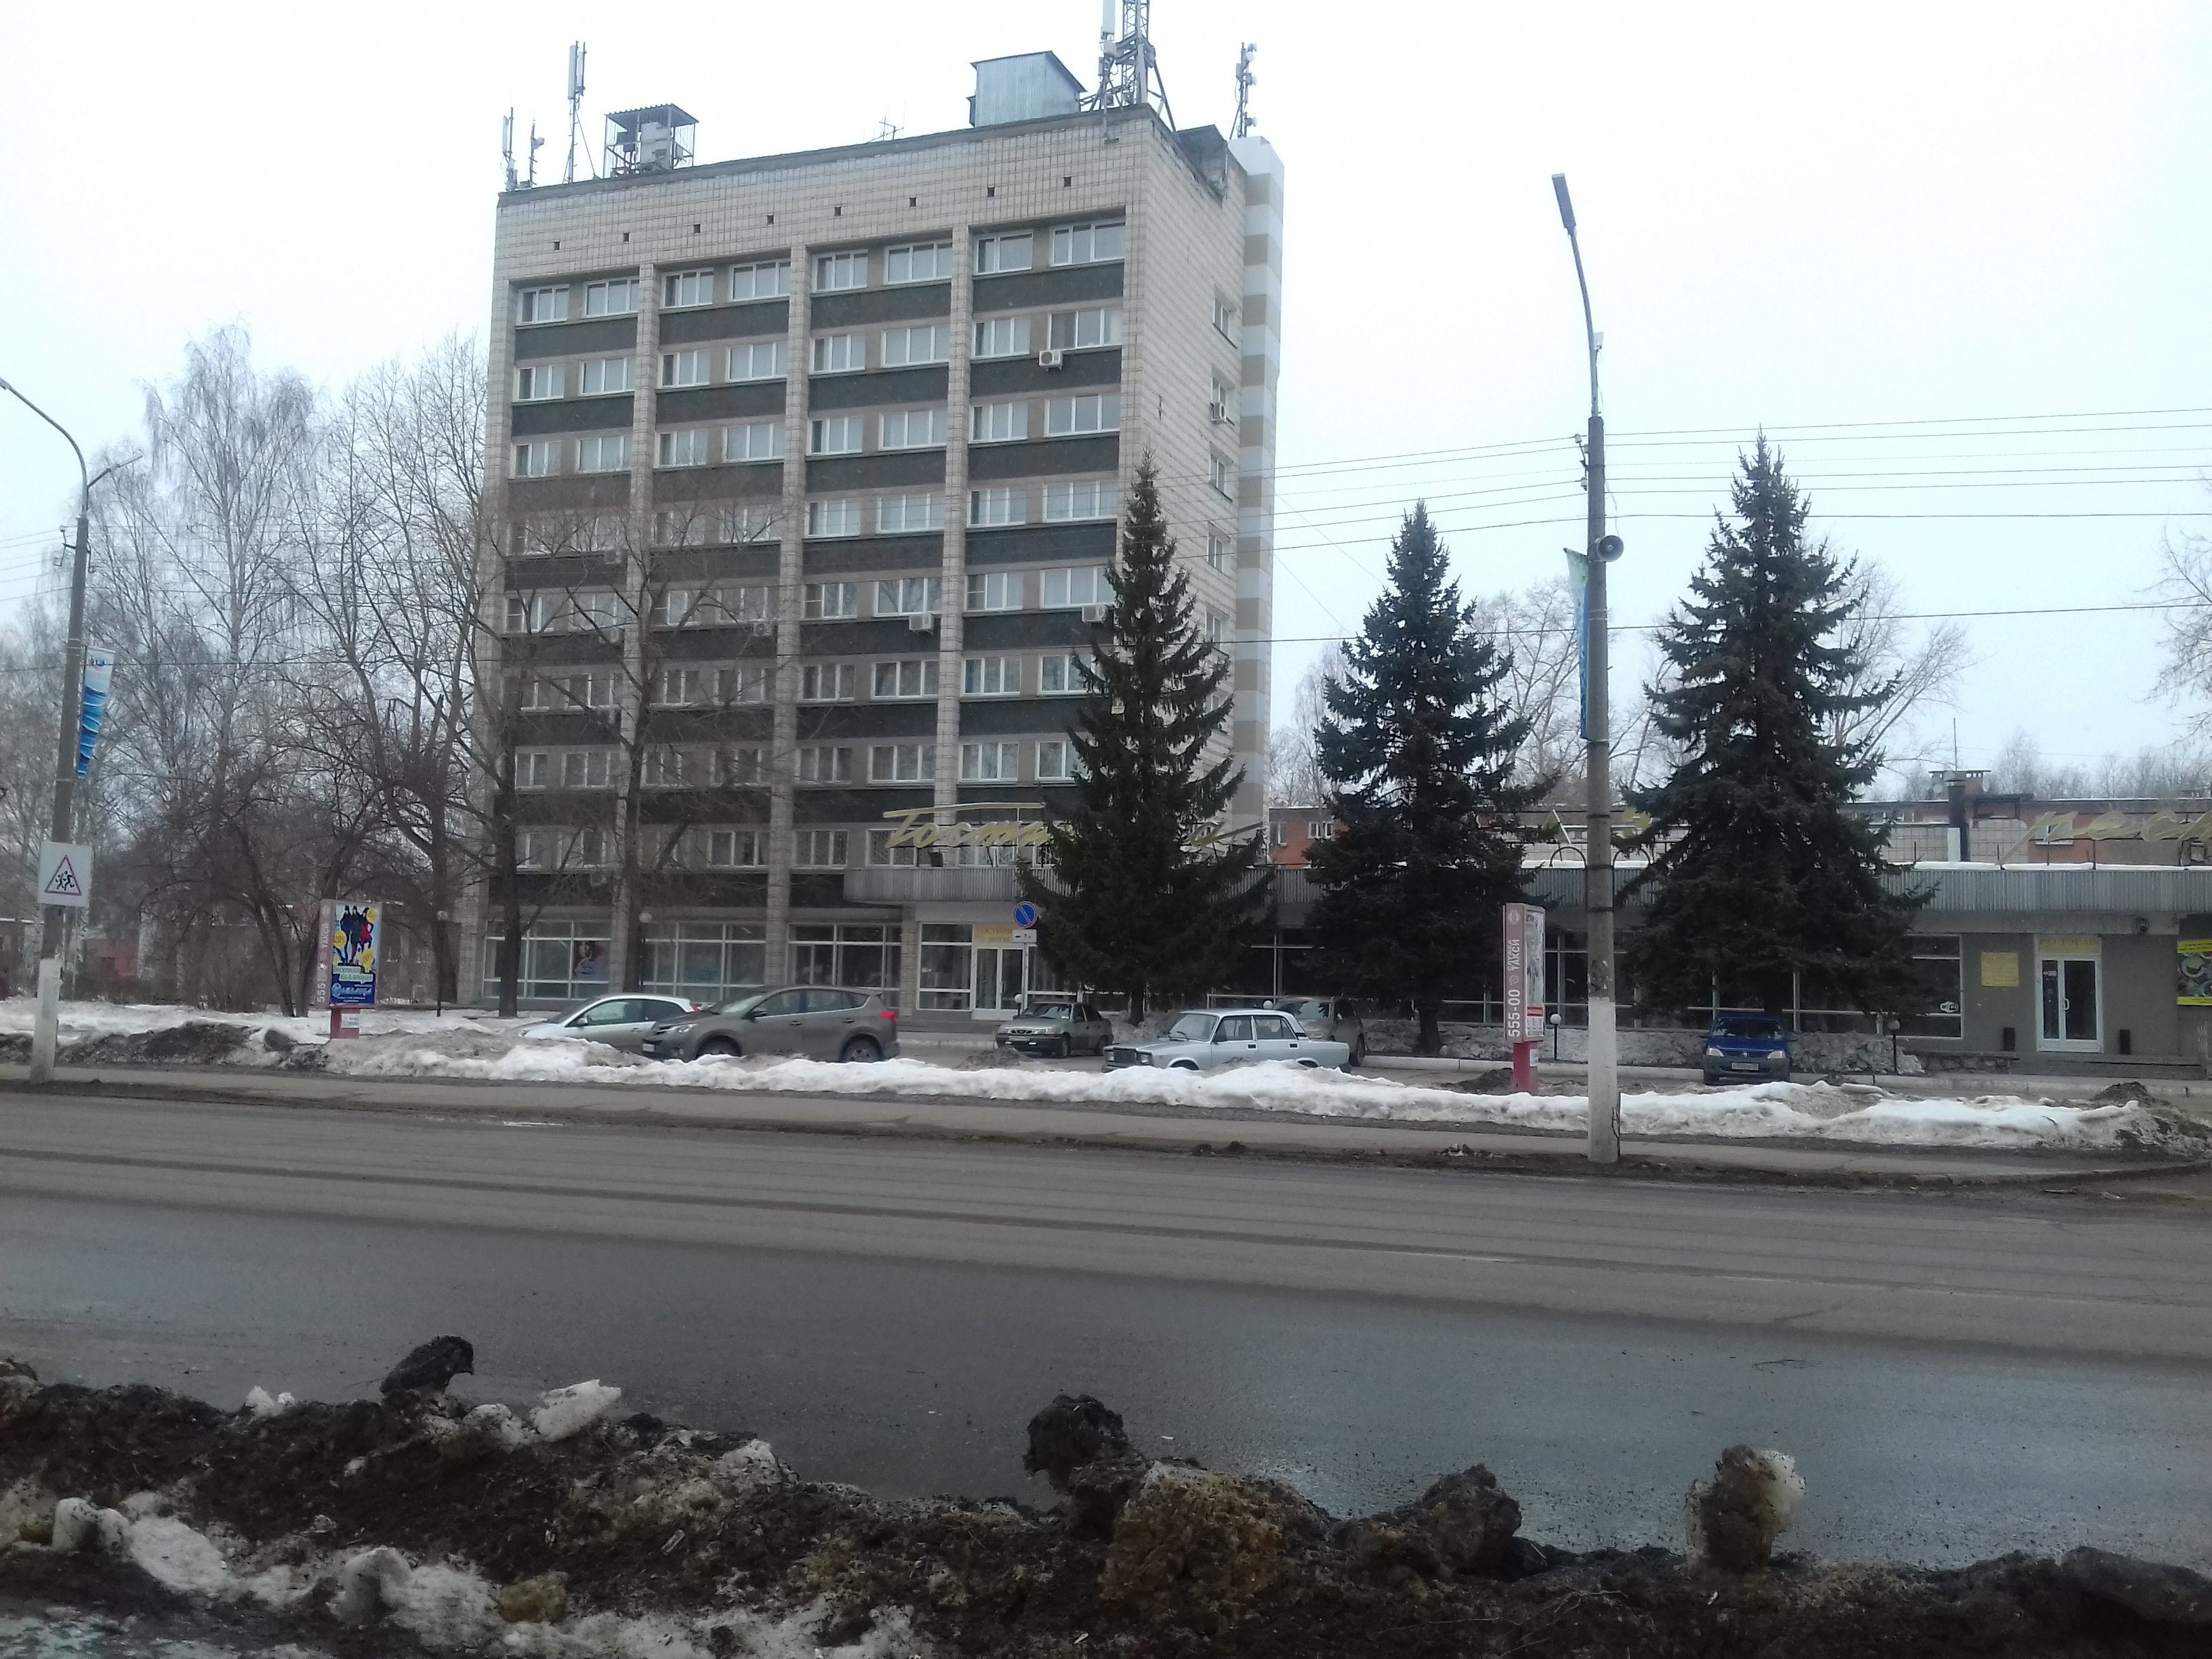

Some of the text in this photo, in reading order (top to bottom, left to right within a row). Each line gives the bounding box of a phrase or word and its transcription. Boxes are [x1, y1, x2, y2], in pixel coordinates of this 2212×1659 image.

[883, 802, 1263, 848] Гостиа
[1511, 939, 1520, 971] ТАКСИ
[1508, 989, 1520, 1038] 555-00
